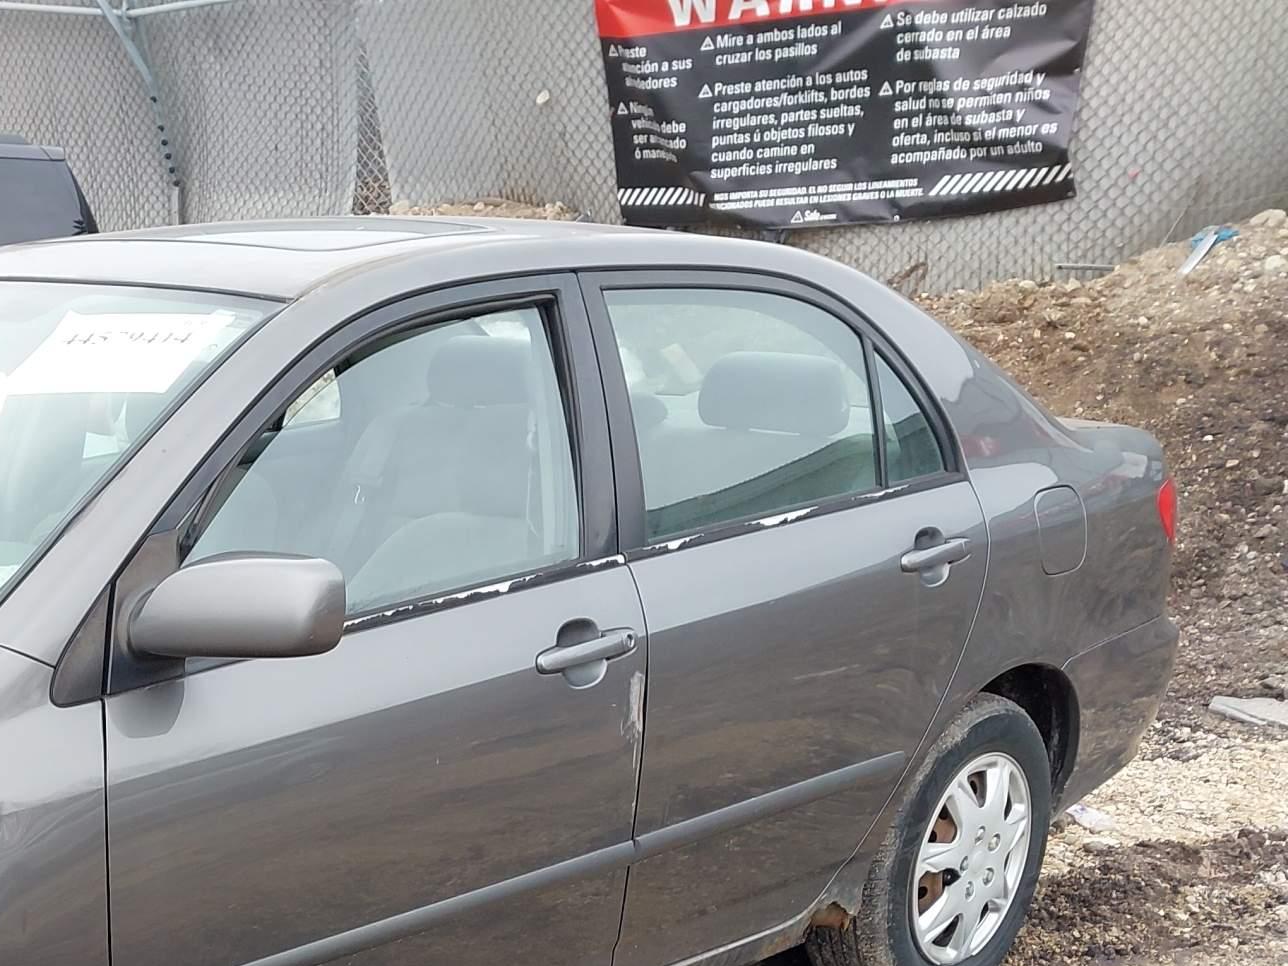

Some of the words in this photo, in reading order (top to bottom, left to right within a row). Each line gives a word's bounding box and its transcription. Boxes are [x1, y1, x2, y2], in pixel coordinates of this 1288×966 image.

[896, 12, 912, 26] Se
[915, 11, 947, 25] debe
[951, 8, 994, 23] utilizar
[998, 2, 1047, 20] calzado
[716, 35, 743, 49] Mire
[746, 36, 753, 45] a
[757, 28, 794, 43] ambos
[797, 25, 827, 39] lados
[830, 21, 841, 35] al
[896, 28, 943, 44] cerrado
[946, 30, 962, 41] en
[966, 25, 978, 40] el
[981, 25, 1011, 39] área
[715, 51, 752, 66] cruzar
[755, 48, 772, 61] los
[775, 44, 818, 62] pasillos
[896, 47, 911, 62] de
[913, 46, 961, 60] subasta
[622, 60, 658, 74] ción
[661, 61, 669, 72] a
[671, 59, 693, 71] sus
[714, 82, 751, 96] Preste
[754, 74, 803, 91] atención
[805, 77, 812, 86] a
[815, 71, 832, 85] los
[835, 69, 868, 83] autos
[895, 80, 915, 94] Por
[918, 78, 950, 95] reglas
[953, 77, 969, 91] de
[972, 71, 1034, 91] seguridad
[1037, 72, 1046, 85] y
[713, 91, 828, 114] cargadores/forklifts,
[830, 85, 870, 99] bordes
[895, 97, 926, 112] salud
[928, 98, 940, 109] no
[941, 97, 954, 109] se
[957, 92, 1011, 111] permiten
[1015, 88, 1051, 102] niños
[661, 120, 686, 133] debe
[712, 113, 778, 130] irregulares,
[780, 108, 817, 124] partes
[820, 104, 865, 119] sueltas,
[893, 117, 908, 130] en
[911, 114, 922, 127] el
[925, 112, 949, 126] área
[950, 113, 962, 126] de
[965, 109, 1012, 126] subasta
[1016, 108, 1025, 122] y
[633, 134, 648, 144] ser
[712, 132, 750, 148] puntas
[763, 126, 805, 143] objetos
[807, 123, 844, 137] filosos
[847, 122, 855, 136] y
[892, 132, 931, 147] oferta,
[934, 129, 971, 144] incluso
[972, 128, 982, 140] si
[984, 127, 995, 140] el
[998, 124, 1038, 138] menor
[1041, 122, 1058, 134] es
[711, 147, 753, 163] cuando
[756, 144, 797, 159] camine
[800, 143, 815, 155] en
[891, 147, 967, 165] acompañado
[969, 146, 988, 160] por
[990, 145, 1004, 156] un
[1007, 140, 1043, 154] adulto
[710, 163, 772, 180] superficies
[775, 158, 837, 174] irregulares
[708, 200, 753, 211] NCIONADOS
[754, 198, 775, 208] PUEDE
[775, 196, 808, 206] RESULTAR
[809, 195, 818, 204] EN
[819, 193, 852, 203] LESIONES
[852, 191, 879, 201] GRAVES
[886, 190, 894, 198] LA
[713, 192, 729, 202] NOS
[729, 190, 758, 200] IMPORTA
[758, 189, 768, 198] SU
[808, 185, 816, 194] EL
[817, 184, 828, 194] NO
[854, 181, 867, 191] LOS
[868, 178, 919, 190] LINEAMIENTOS
